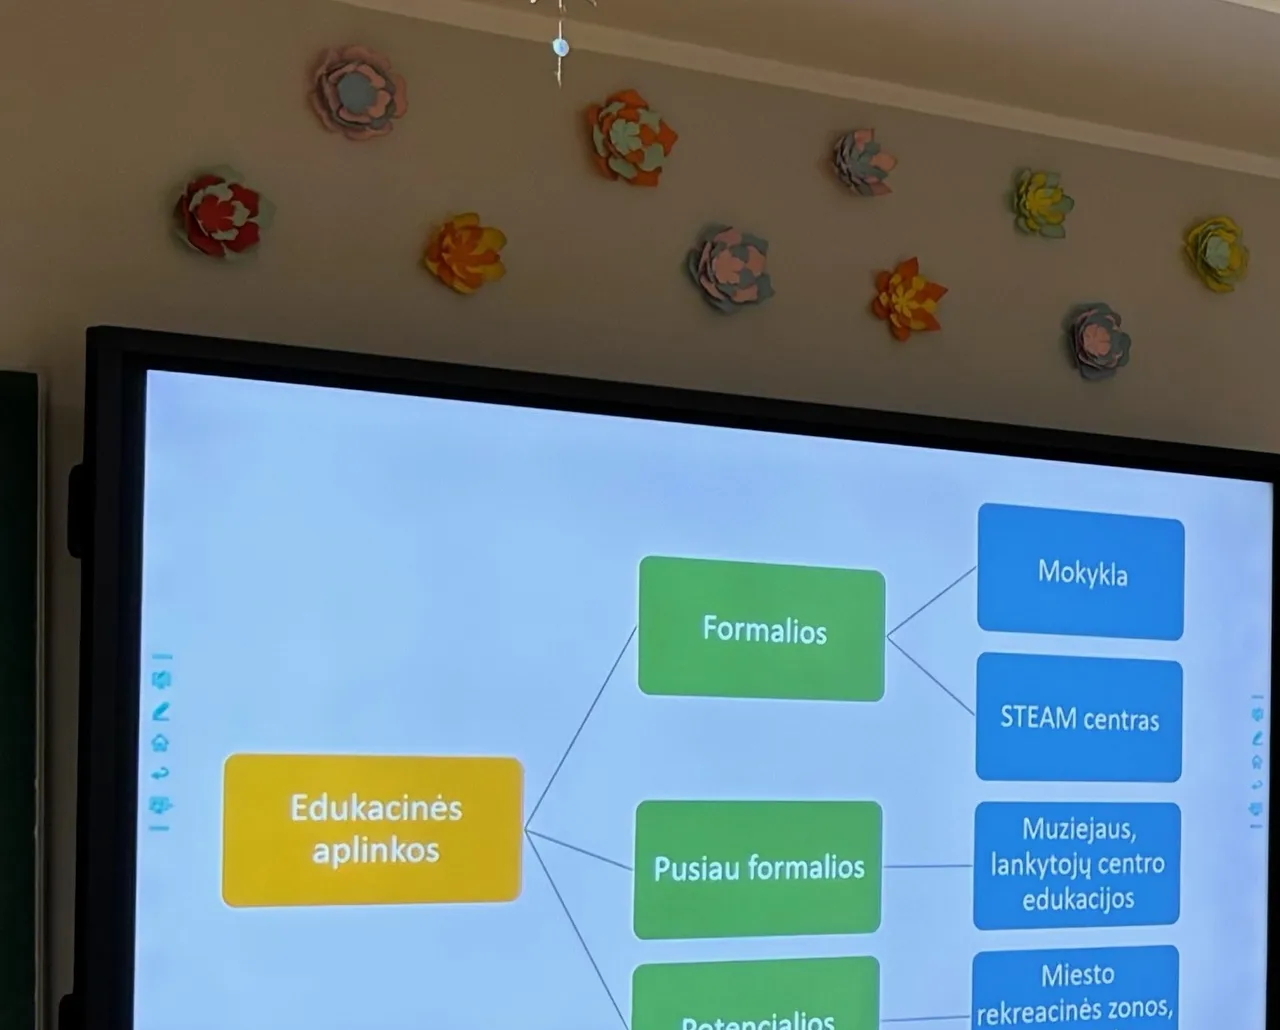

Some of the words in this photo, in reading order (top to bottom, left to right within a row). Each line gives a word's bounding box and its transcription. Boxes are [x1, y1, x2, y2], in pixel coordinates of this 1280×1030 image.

[1038, 558, 1128, 589] Mokykla
[703, 614, 828, 645] Formalios
[1000, 704, 1077, 730] STEAM
[1083, 709, 1160, 732] centras
[290, 792, 463, 822] Edukacinės
[1022, 816, 1137, 845] Muziejaus,
[312, 834, 441, 870] aplinkos
[991, 851, 1092, 880] lankytojų
[1098, 854, 1165, 875] centro
[654, 855, 740, 882] Pusiau
[748, 852, 865, 880] formalios
[1022, 886, 1135, 914] edukacijos
[1041, 963, 1115, 988] Miesto
[977, 997, 1102, 1026] rekreacinės
[1108, 998, 1173, 1020] zonos,
